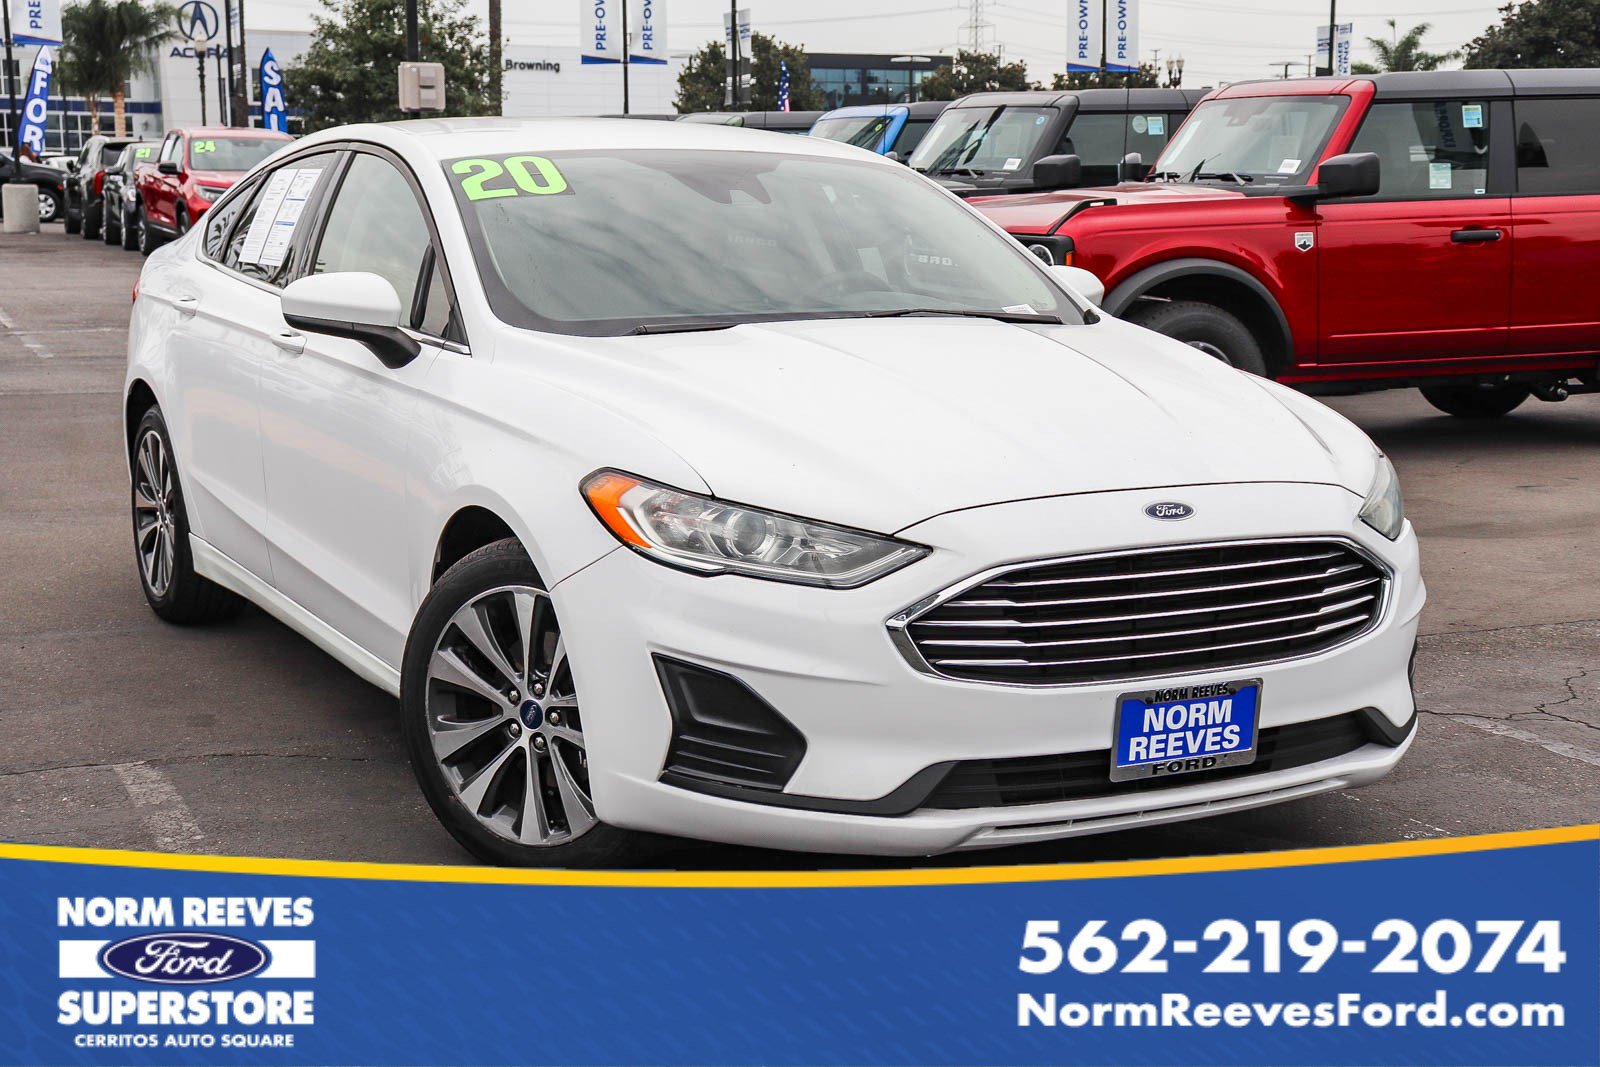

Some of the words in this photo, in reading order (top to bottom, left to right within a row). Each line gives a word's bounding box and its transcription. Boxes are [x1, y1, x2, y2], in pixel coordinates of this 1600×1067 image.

[505, 60, 560, 73] Browning
[135, 148, 151, 158] 21
[194, 140, 216, 153] 24
[451, 155, 568, 200] 20
[1156, 504, 1185, 517] Ford
[1154, 688, 1188, 703] NORM
[1192, 683, 1229, 699] REEVES
[1143, 699, 1232, 733] NORM
[1128, 724, 1240, 761] REEVES
[1152, 756, 1217, 775] FORD
